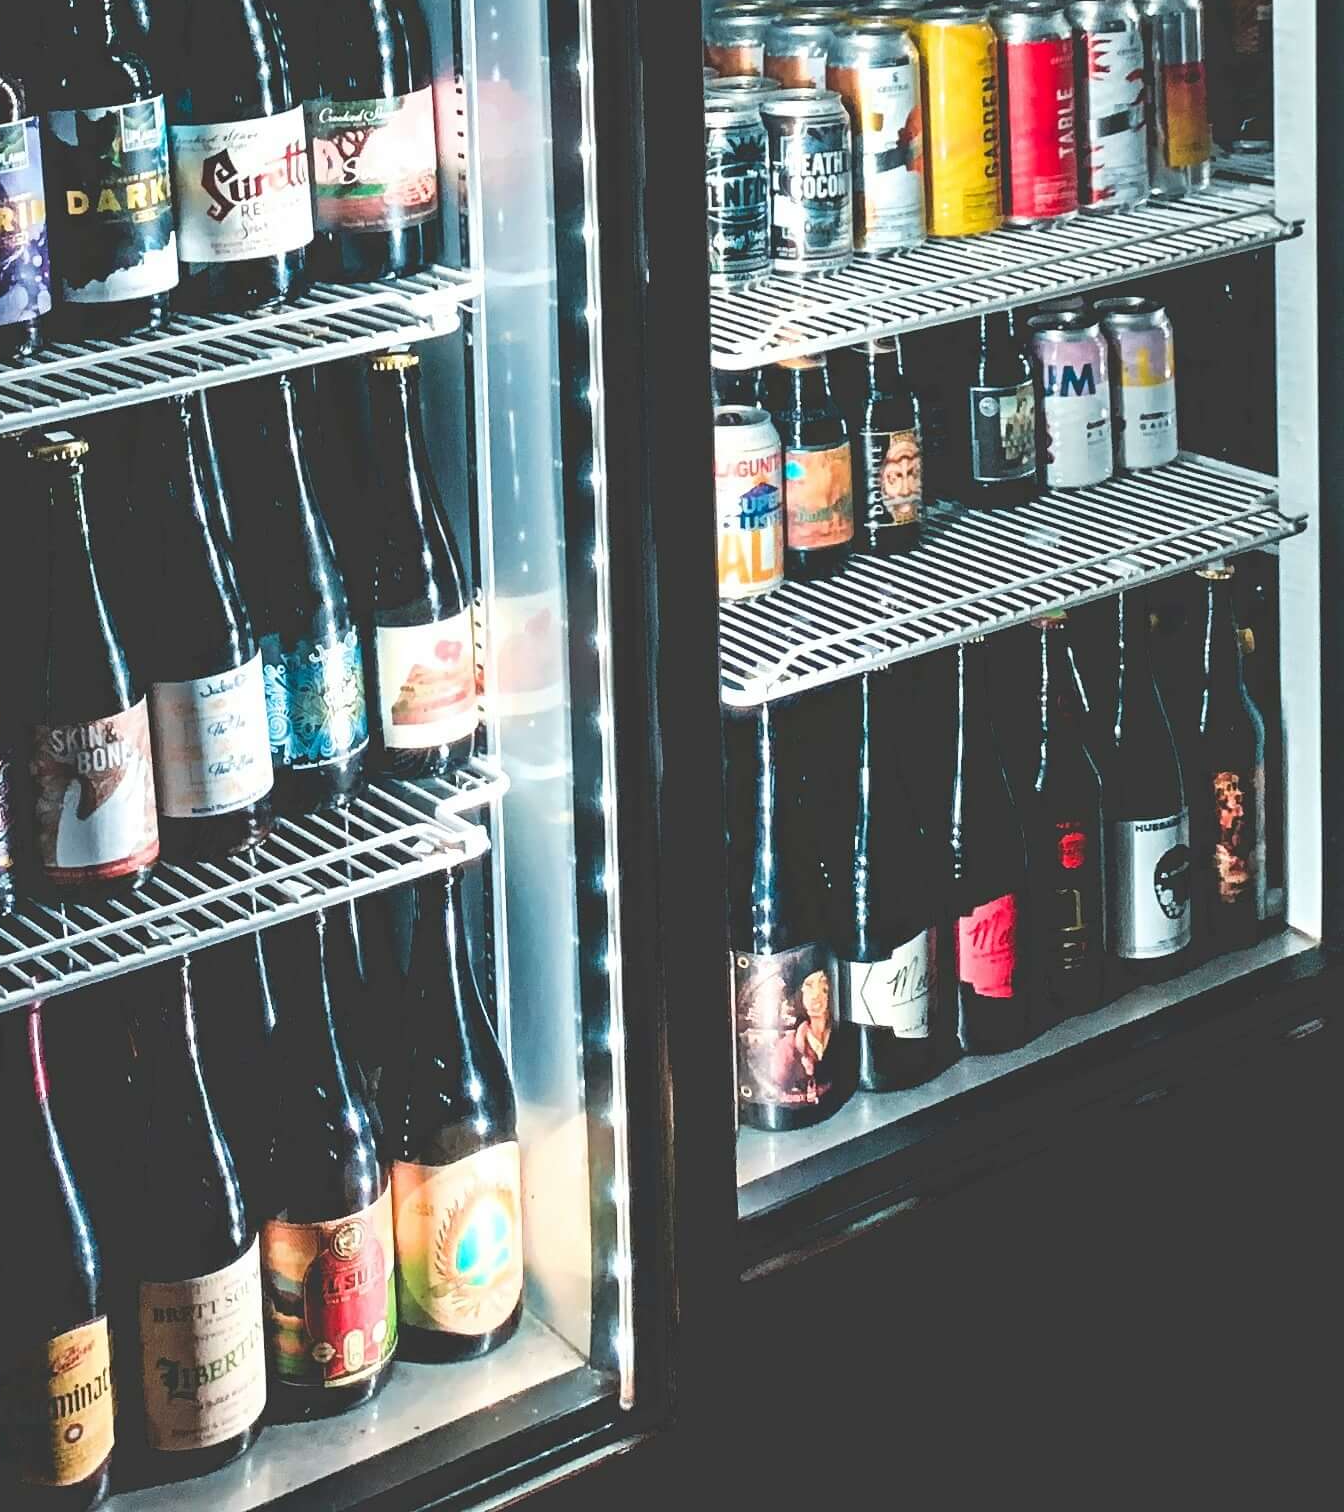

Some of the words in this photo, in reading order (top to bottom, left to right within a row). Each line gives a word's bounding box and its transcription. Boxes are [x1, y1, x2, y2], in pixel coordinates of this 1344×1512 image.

[980, 75, 997, 179] GARDEN
[1057, 88, 1074, 159] TABLE
[66, 174, 172, 216] DARK
[51, 723, 106, 755] SKIN
